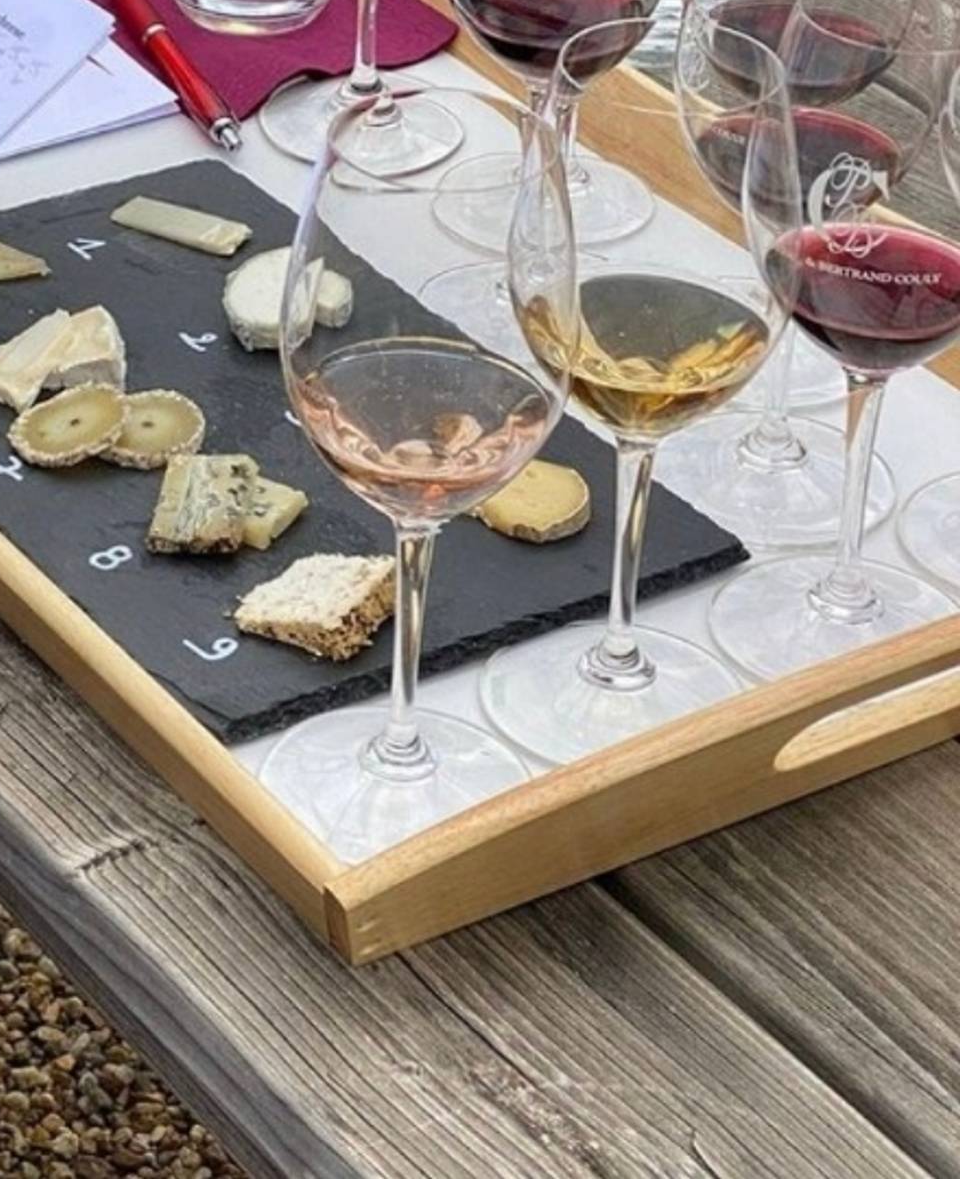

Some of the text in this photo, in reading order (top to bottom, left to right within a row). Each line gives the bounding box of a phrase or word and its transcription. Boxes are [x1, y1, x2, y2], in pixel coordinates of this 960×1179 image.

[67, 238, 106, 260] 1
[179, 332, 218, 352] 2
[89, 545, 133, 570] 8
